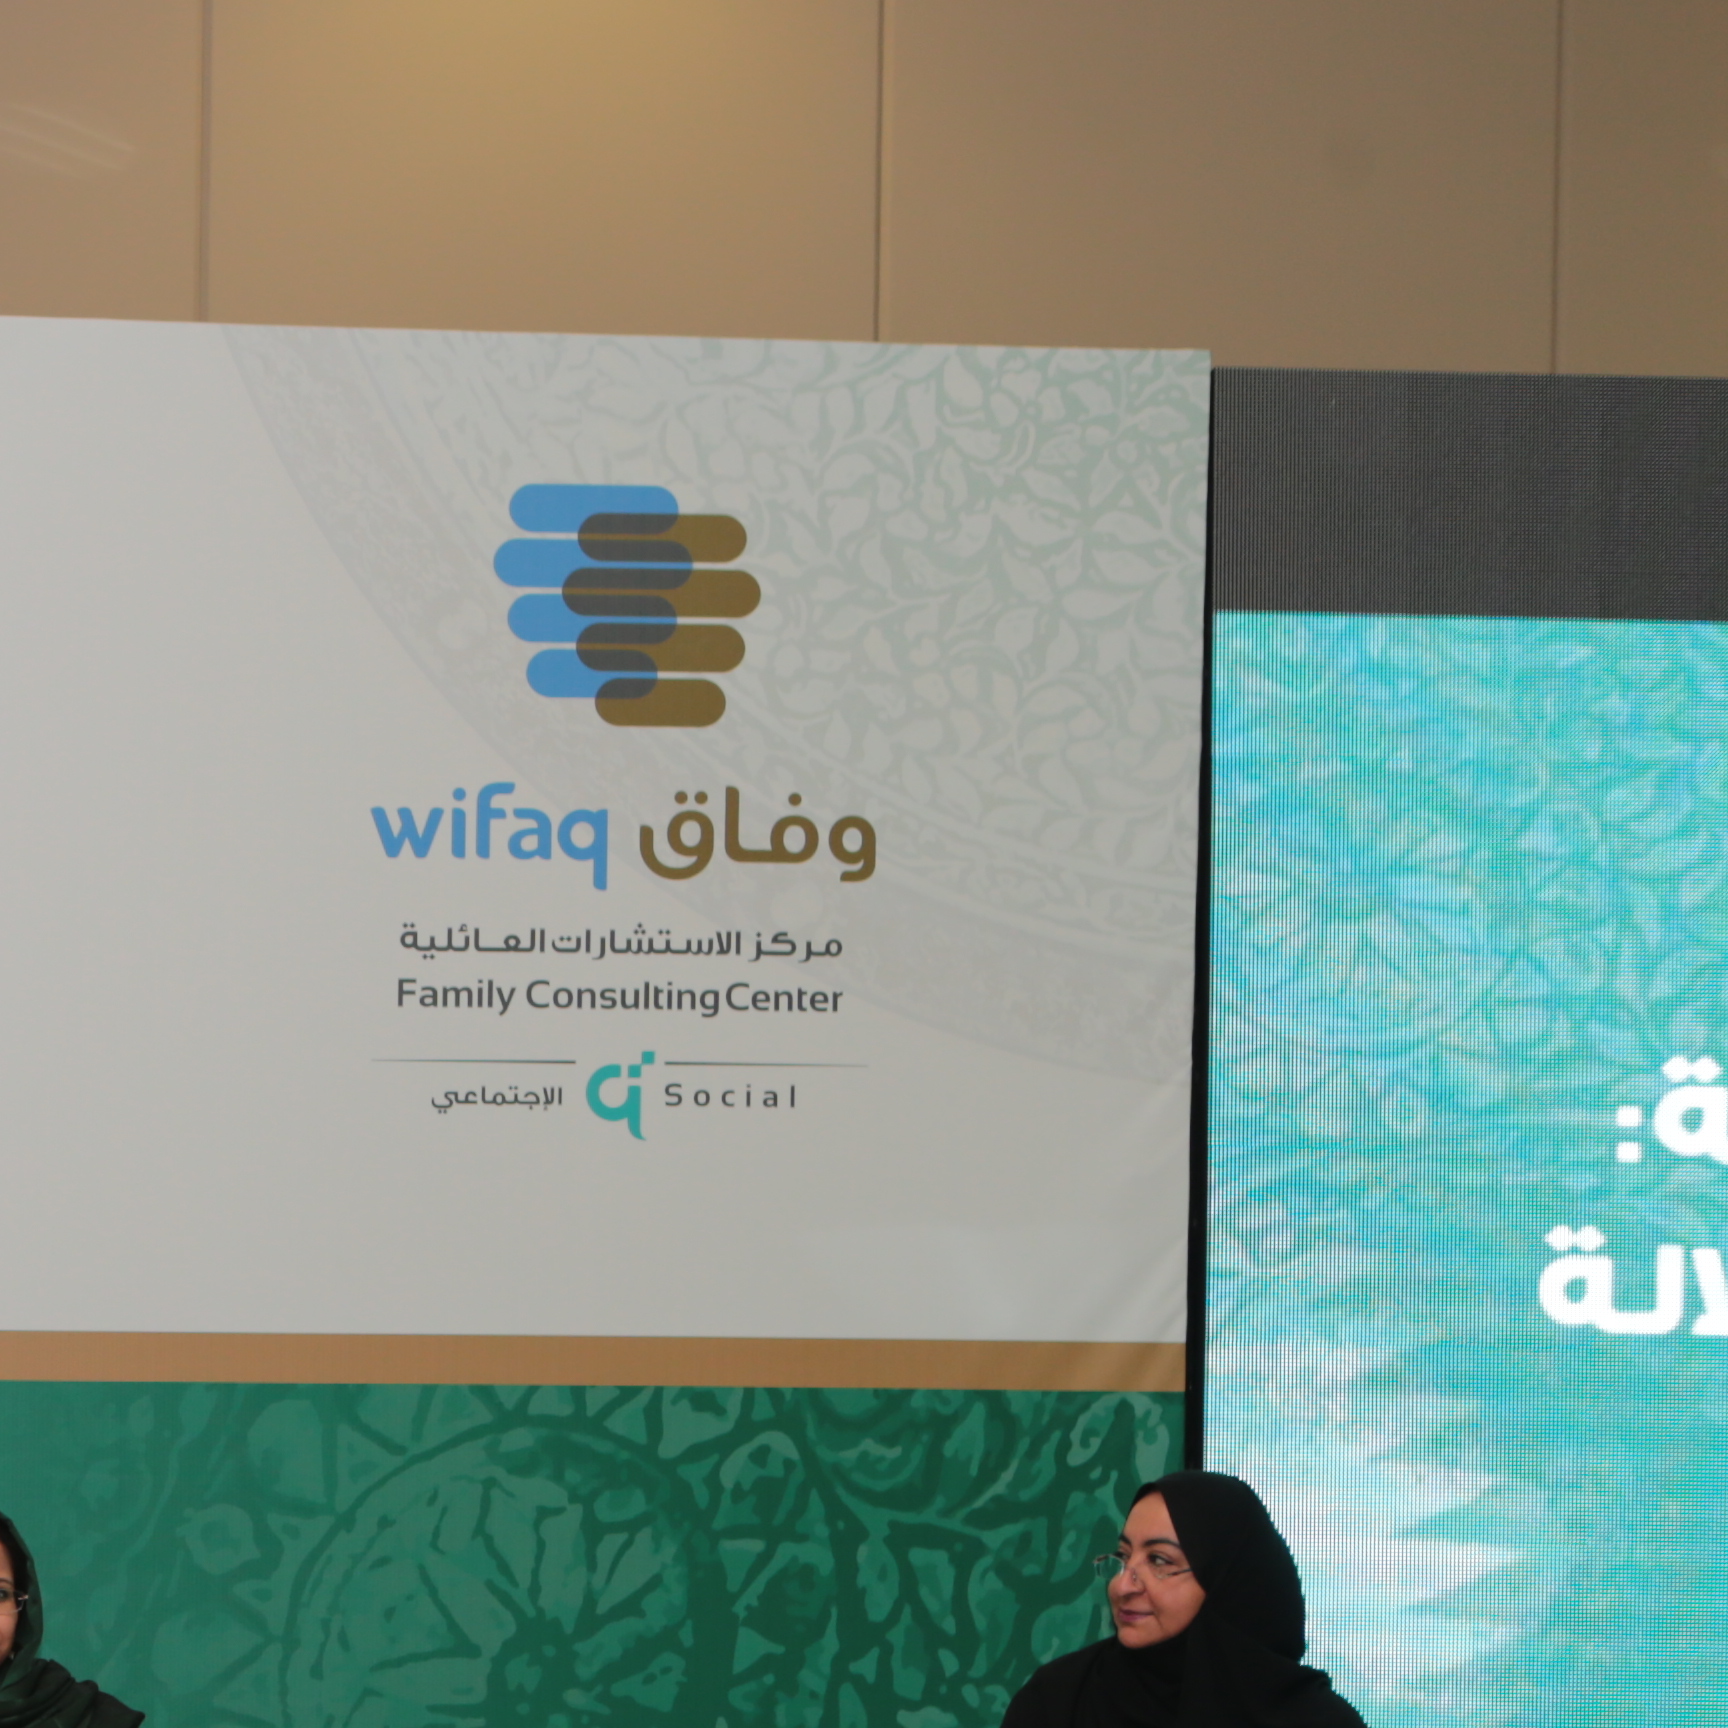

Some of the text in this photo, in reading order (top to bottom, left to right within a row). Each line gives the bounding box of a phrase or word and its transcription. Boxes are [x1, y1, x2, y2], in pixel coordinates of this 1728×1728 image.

[370, 781, 609, 892] wifaq
[639, 785, 877, 883] وفاق
[398, 922, 844, 963] مركز الاستشارات العائلية
[396, 977, 844, 1019] Family Consulting Center
[664, 1082, 797, 1109] Social
